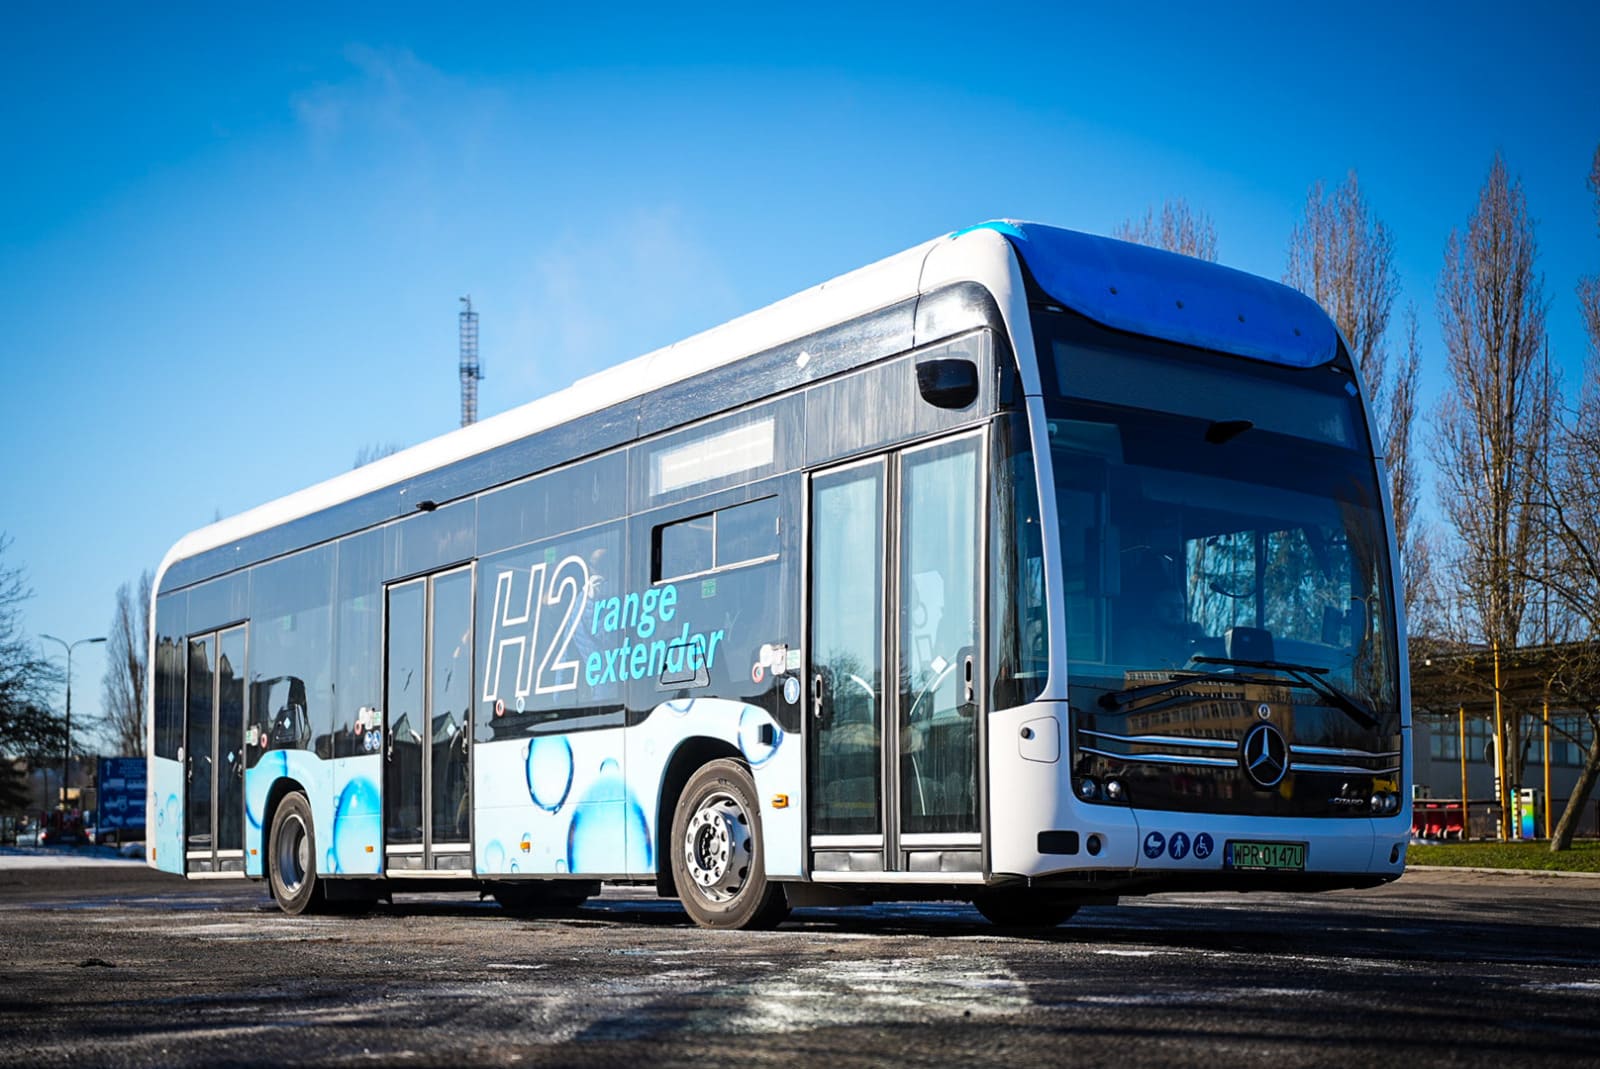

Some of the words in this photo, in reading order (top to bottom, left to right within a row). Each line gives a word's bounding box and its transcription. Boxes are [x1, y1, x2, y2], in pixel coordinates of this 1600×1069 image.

[482, 554, 590, 702] H2
[591, 583, 678, 639] range
[585, 622, 724, 687] extender
[1233, 845, 1260, 865] WPR
[1263, 846, 1303, 867] 0147U
